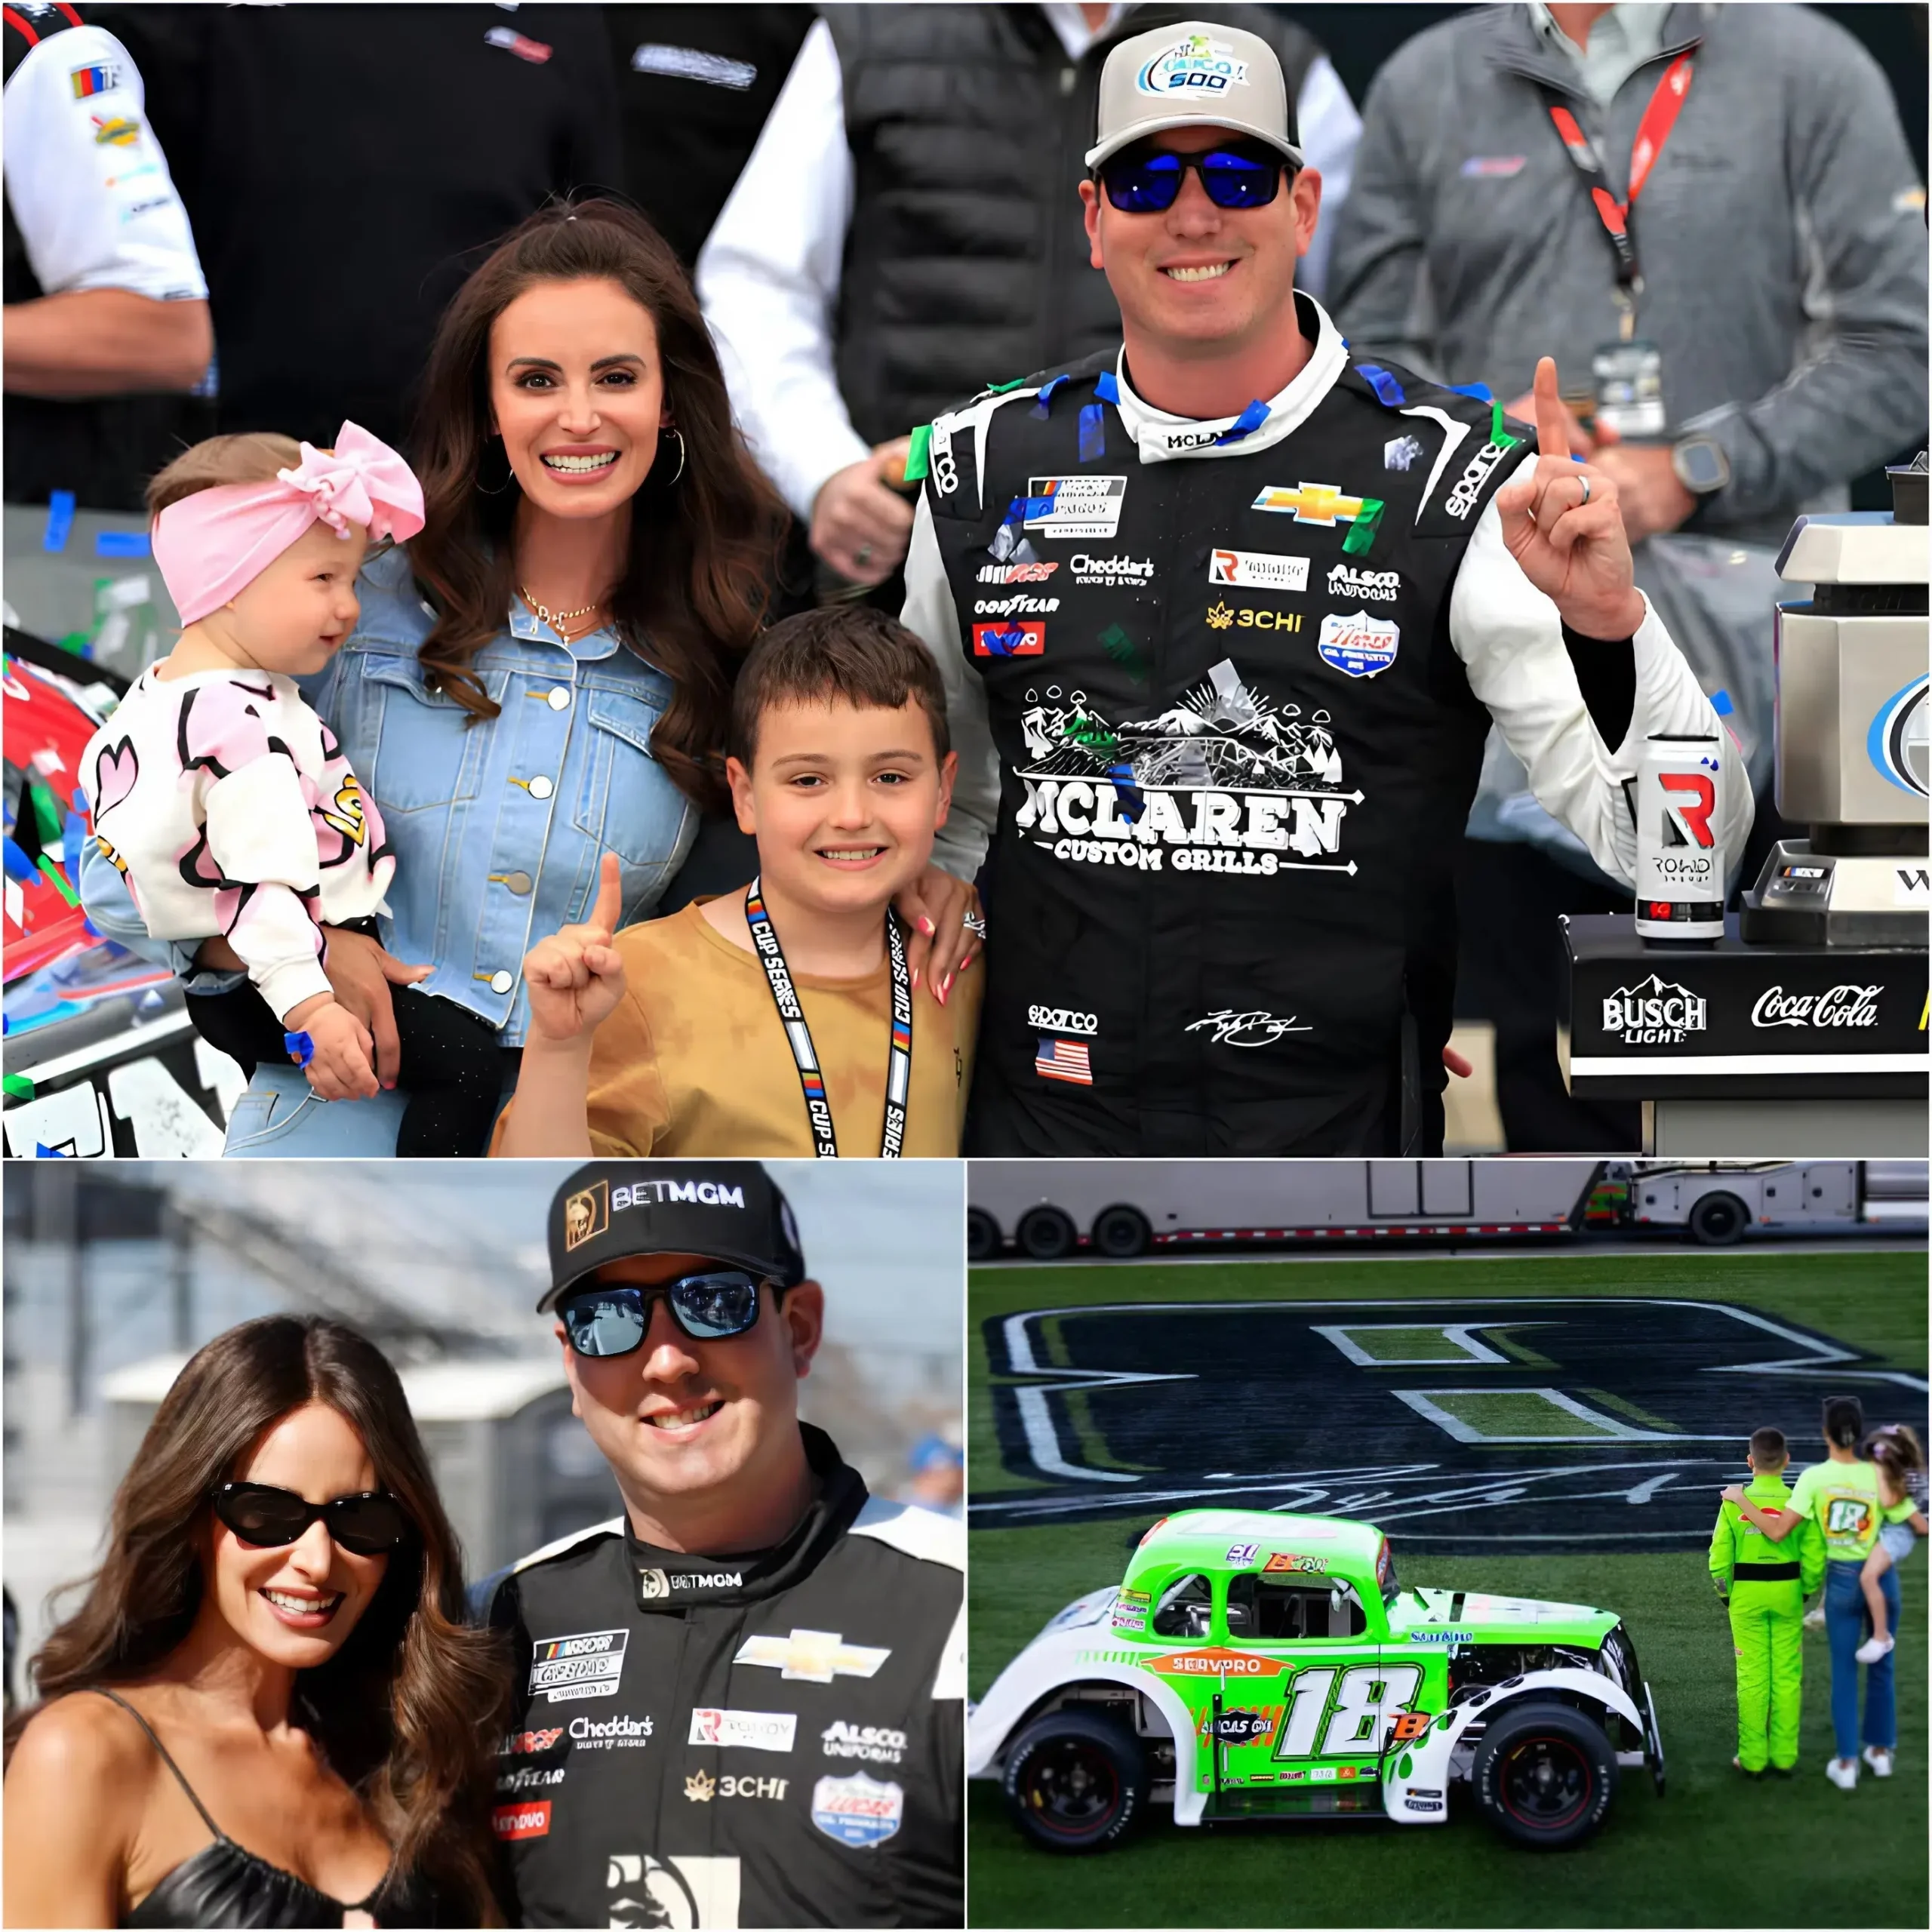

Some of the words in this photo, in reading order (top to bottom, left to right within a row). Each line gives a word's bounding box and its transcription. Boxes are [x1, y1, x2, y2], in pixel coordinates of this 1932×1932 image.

[1236, 609, 1306, 632] 3CHI
[1054, 838, 1162, 870] CUSTOM
[1171, 851, 1278, 875] GRILLS
[752, 922, 779, 955] CUP
[1602, 997, 1706, 1031] BUSCH
[810, 1100, 832, 1139] CUP
[611, 1180, 745, 1212] BETMGM
[1274, 1665, 1423, 1761] 18
[719, 1776, 789, 1801] 3CHI
